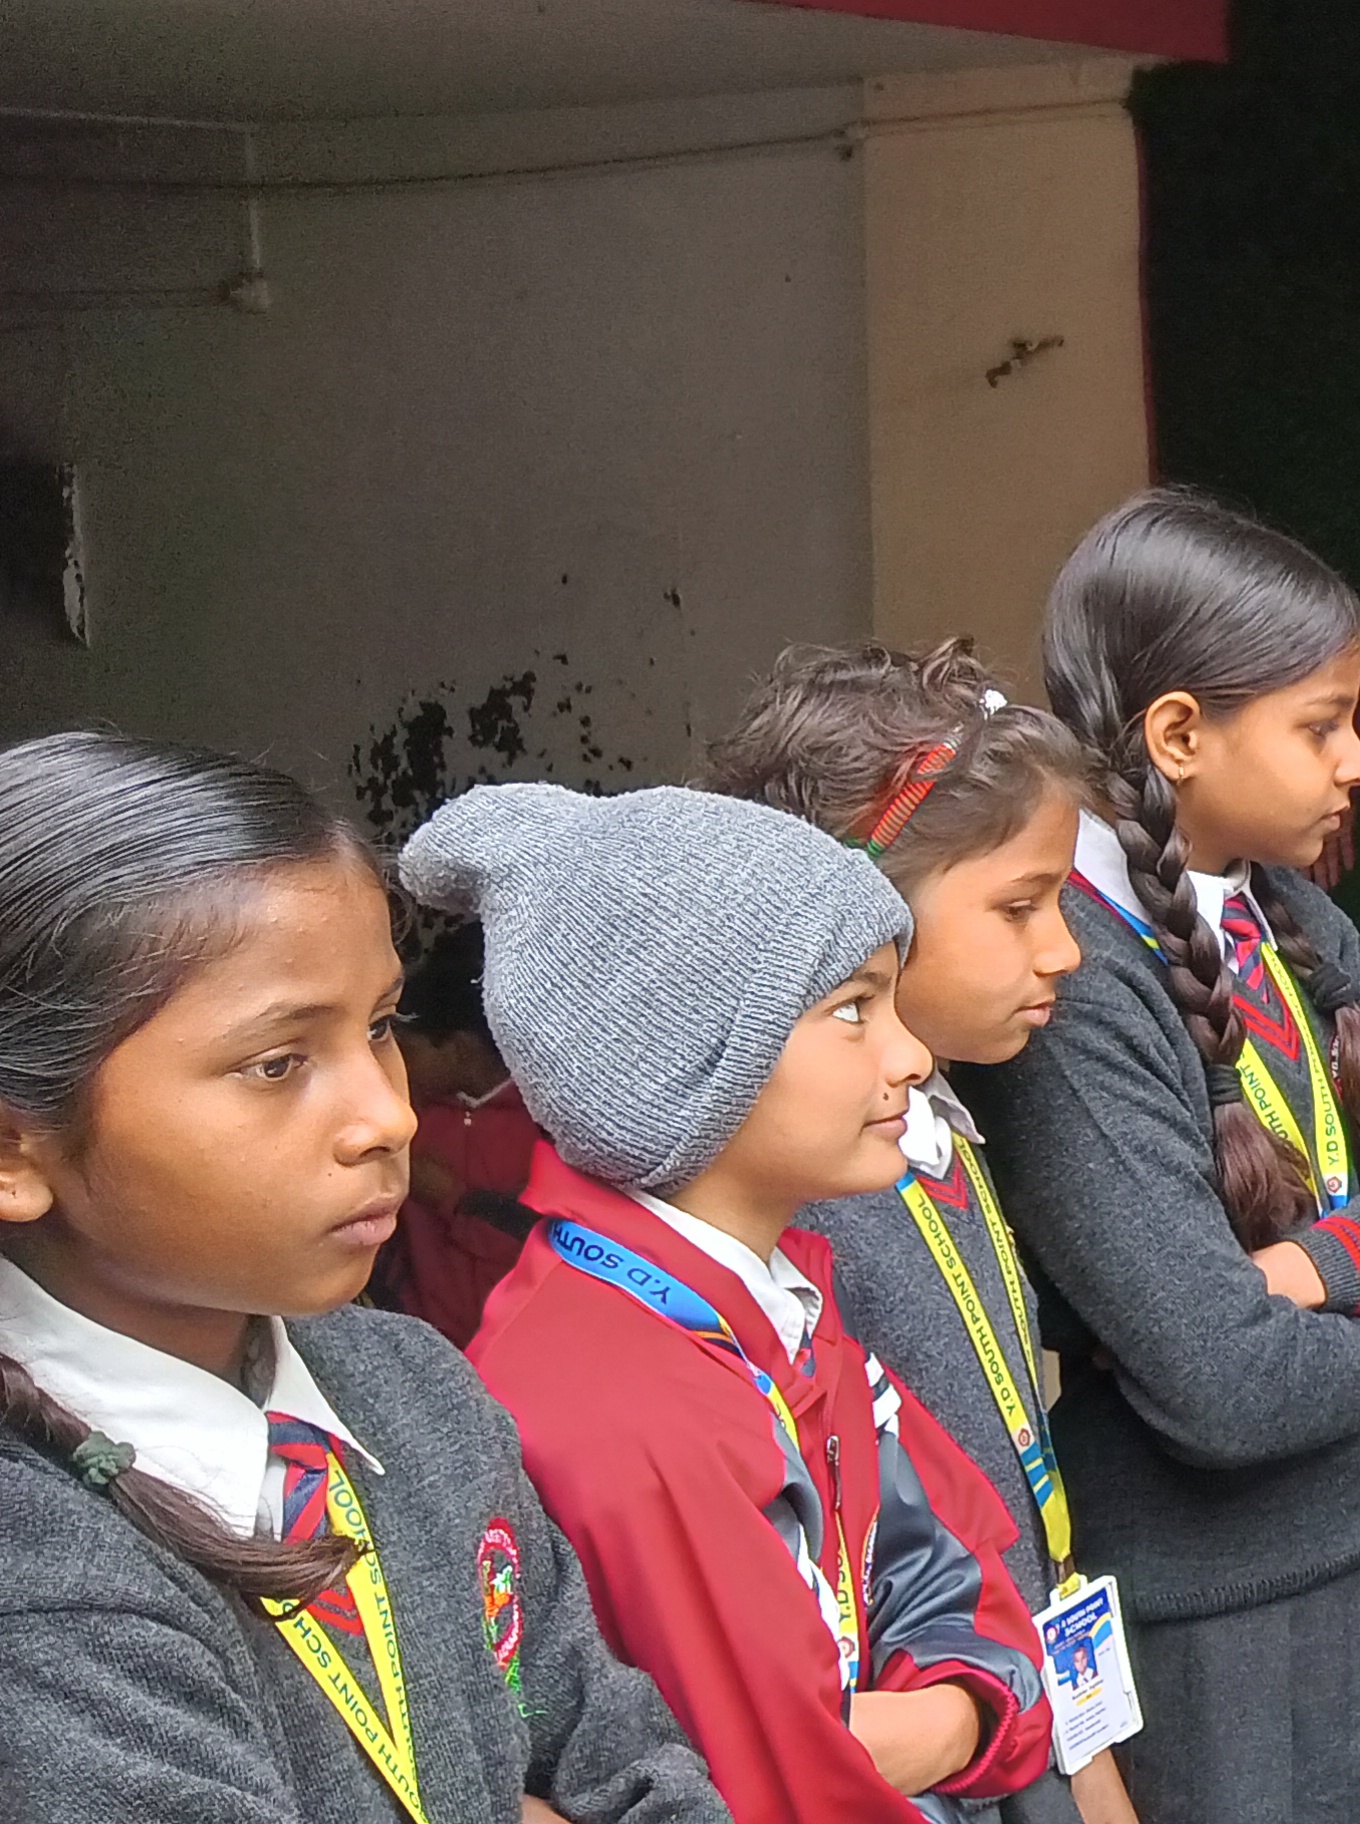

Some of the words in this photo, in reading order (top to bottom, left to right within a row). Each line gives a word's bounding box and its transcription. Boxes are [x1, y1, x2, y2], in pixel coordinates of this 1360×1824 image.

[1240, 1064, 1272, 1111] POINT
[1318, 1079, 1337, 1137] SOUTH
[958, 1138, 992, 1215] SCHOOL
[1327, 1140, 1339, 1166] Y.D
[552, 1222, 625, 1269] SOUTH
[918, 1193, 957, 1269] SCHOOL
[989, 1216, 1012, 1276] POINT
[627, 1268, 671, 1305] Y.D
[952, 1272, 980, 1325] POINT
[976, 1326, 1004, 1385] SOUTH
[1000, 1387, 1016, 1417] Y.D
[374, 1591, 400, 1679] POINT
[328, 1672, 378, 1743] POINT
